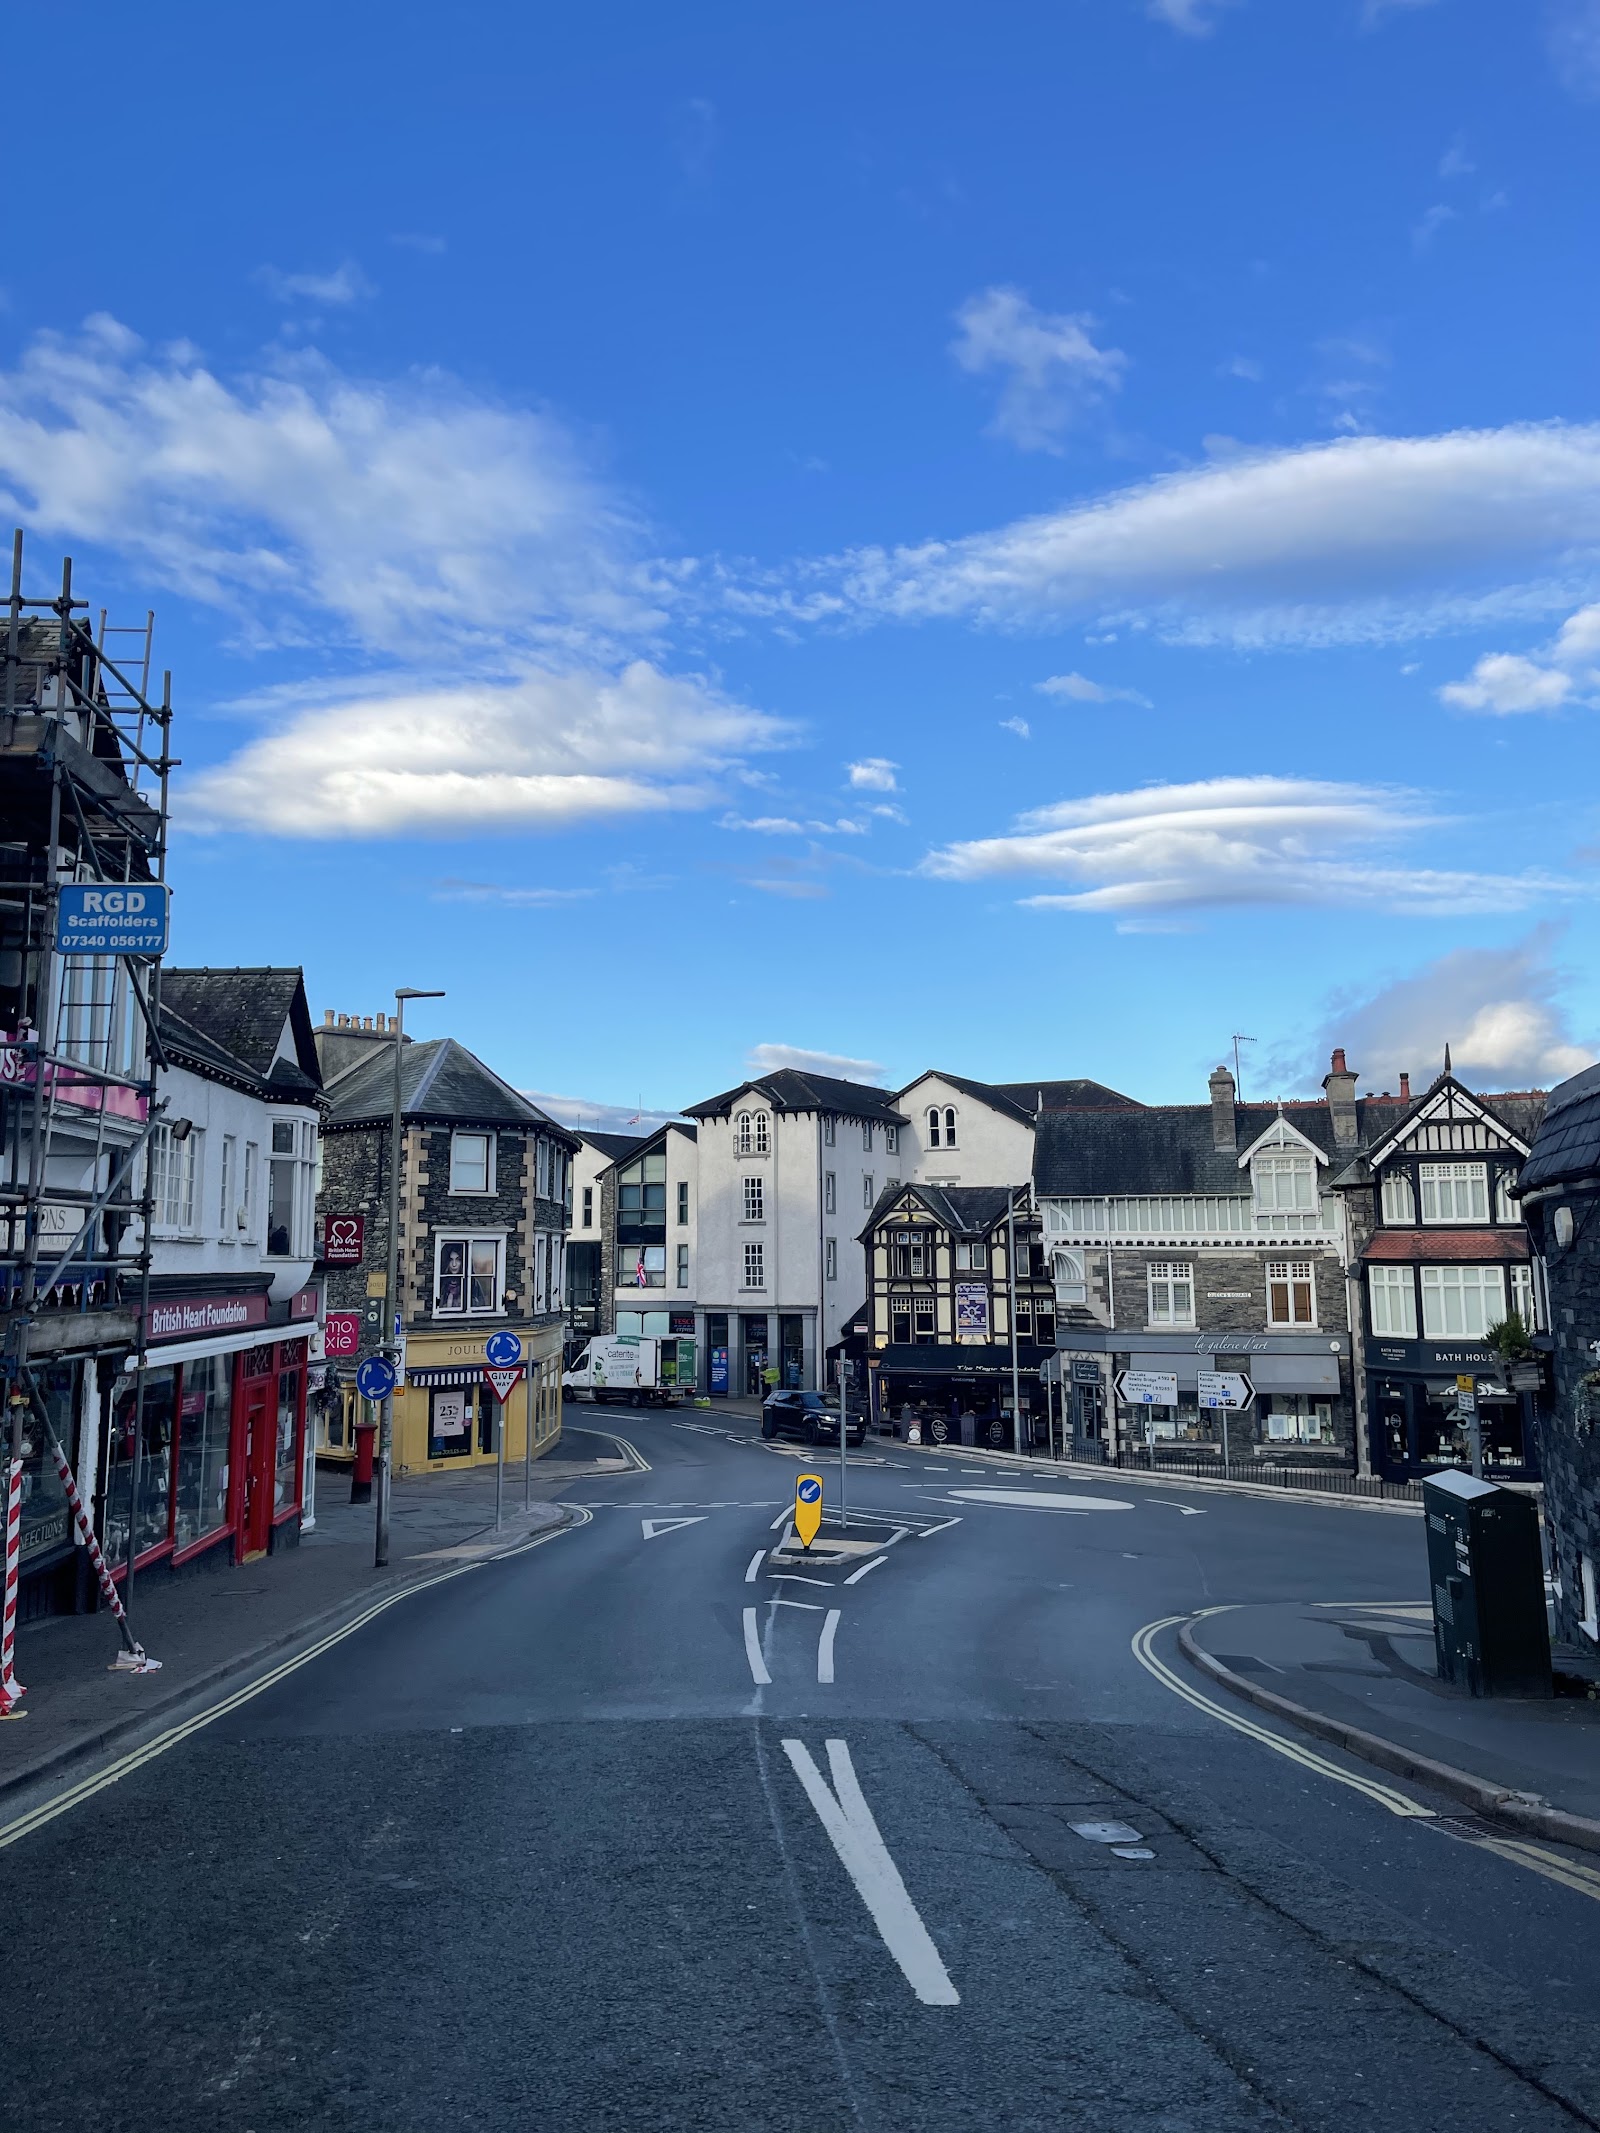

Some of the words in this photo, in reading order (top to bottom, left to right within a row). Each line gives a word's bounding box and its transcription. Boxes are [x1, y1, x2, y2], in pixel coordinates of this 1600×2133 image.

[83, 892, 146, 913] RGD
[67, 915, 158, 927] Scaffolders
[61, 935, 106, 947] 07340
[109, 935, 162, 947] 056177
[152, 1306, 182, 1334] British
[183, 1305, 206, 1329] Heart
[207, 1301, 247, 1326] Foundation
[326, 1320, 353, 1333] mo
[326, 1333, 352, 1349] xie
[1195, 1334, 1205, 1350] la
[1198, 1335, 1240, 1356] galerie
[1243, 1335, 1268, 1351] d'art
[448, 1345, 486, 1356] JOULE
[607, 1350, 634, 1359] caterite
[1435, 1353, 1462, 1361] BATH
[1466, 1353, 1494, 1362] HOUS
[491, 1372, 514, 1380] GIVE
